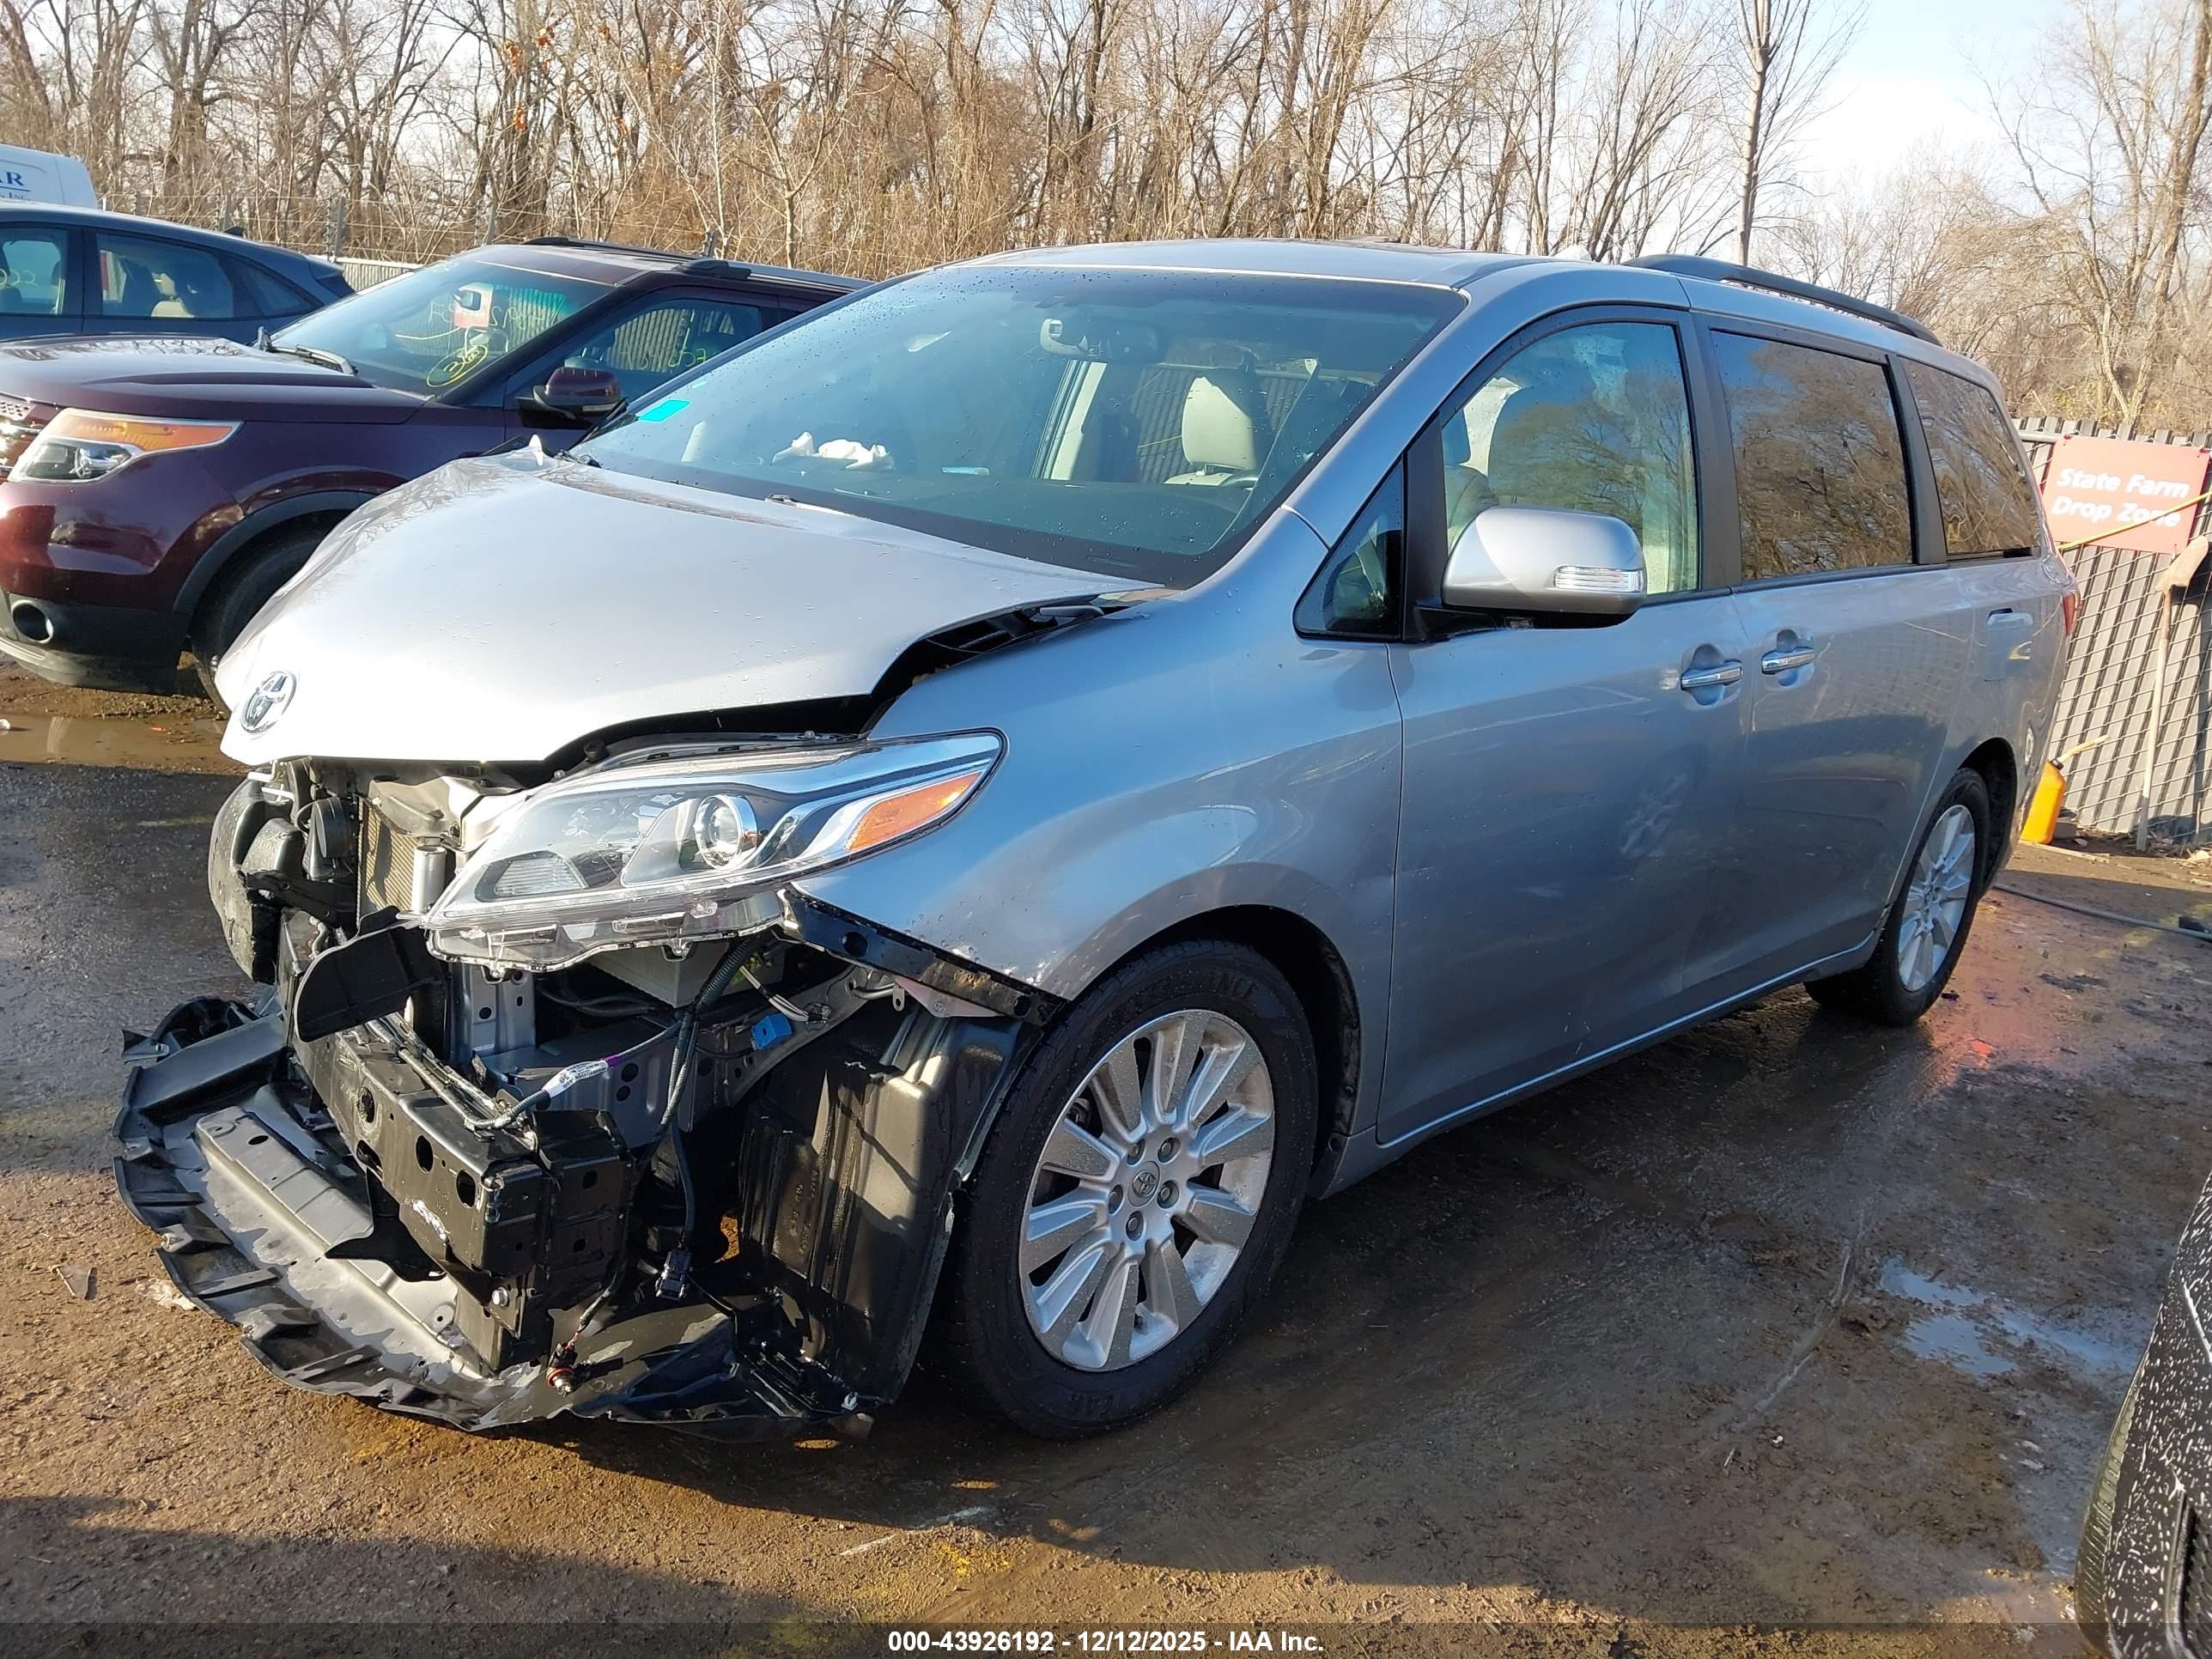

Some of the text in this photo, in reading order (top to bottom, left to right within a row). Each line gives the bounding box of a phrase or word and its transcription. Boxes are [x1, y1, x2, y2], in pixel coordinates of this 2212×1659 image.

[2056, 467, 2191, 499] State Farm
[2051, 495, 2113, 523] Drop
